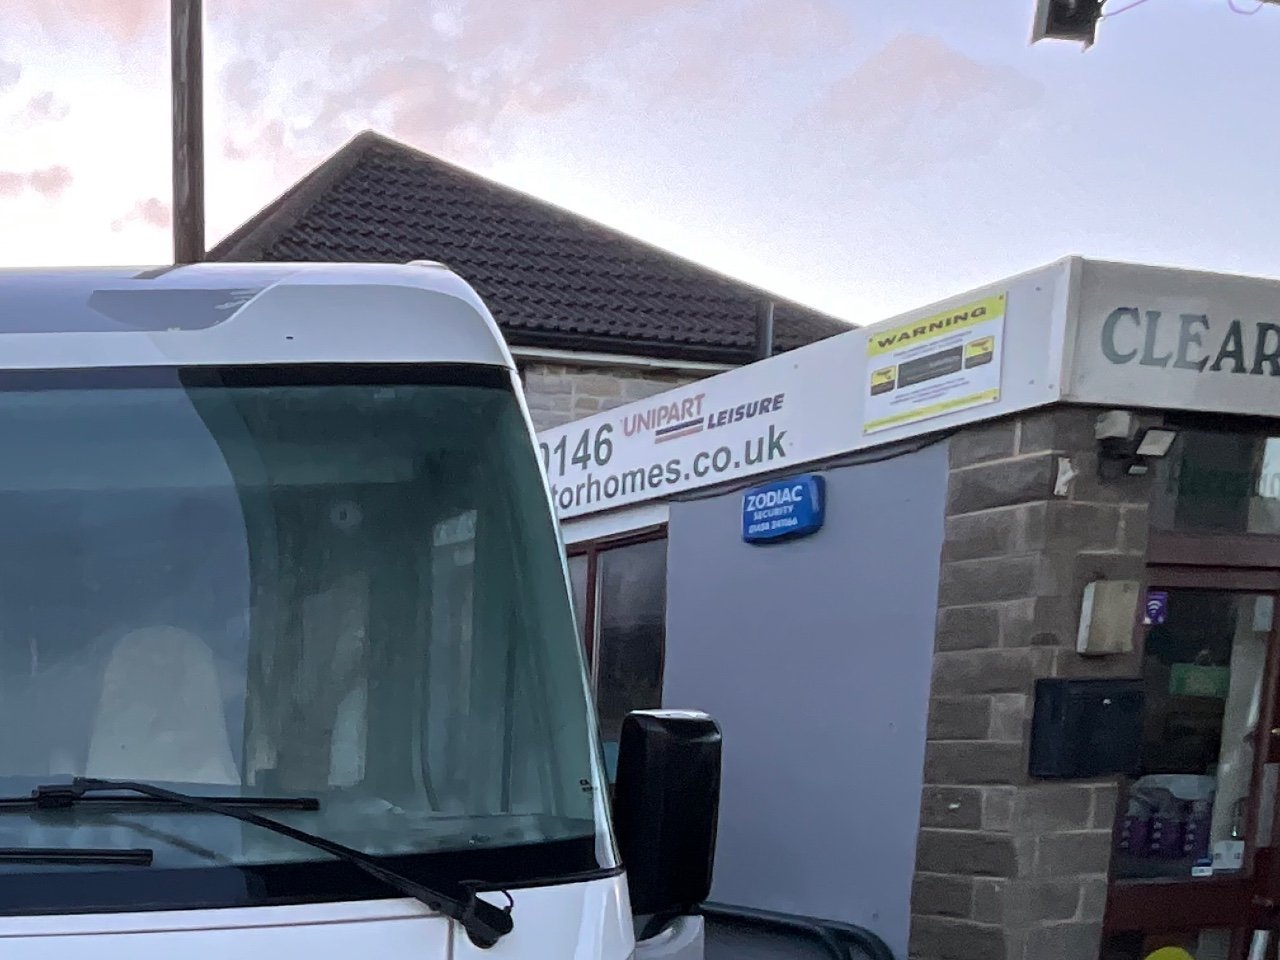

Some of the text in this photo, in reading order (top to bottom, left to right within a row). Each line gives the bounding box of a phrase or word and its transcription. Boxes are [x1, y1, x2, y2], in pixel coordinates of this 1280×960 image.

[877, 306, 987, 348] WARNING
[1101, 306, 1280, 377] CLEAR
[622, 393, 785, 437] UNIPART LEISURE
[746, 485, 803, 511] ZODIAC
[753, 505, 794, 521] SECURITY
